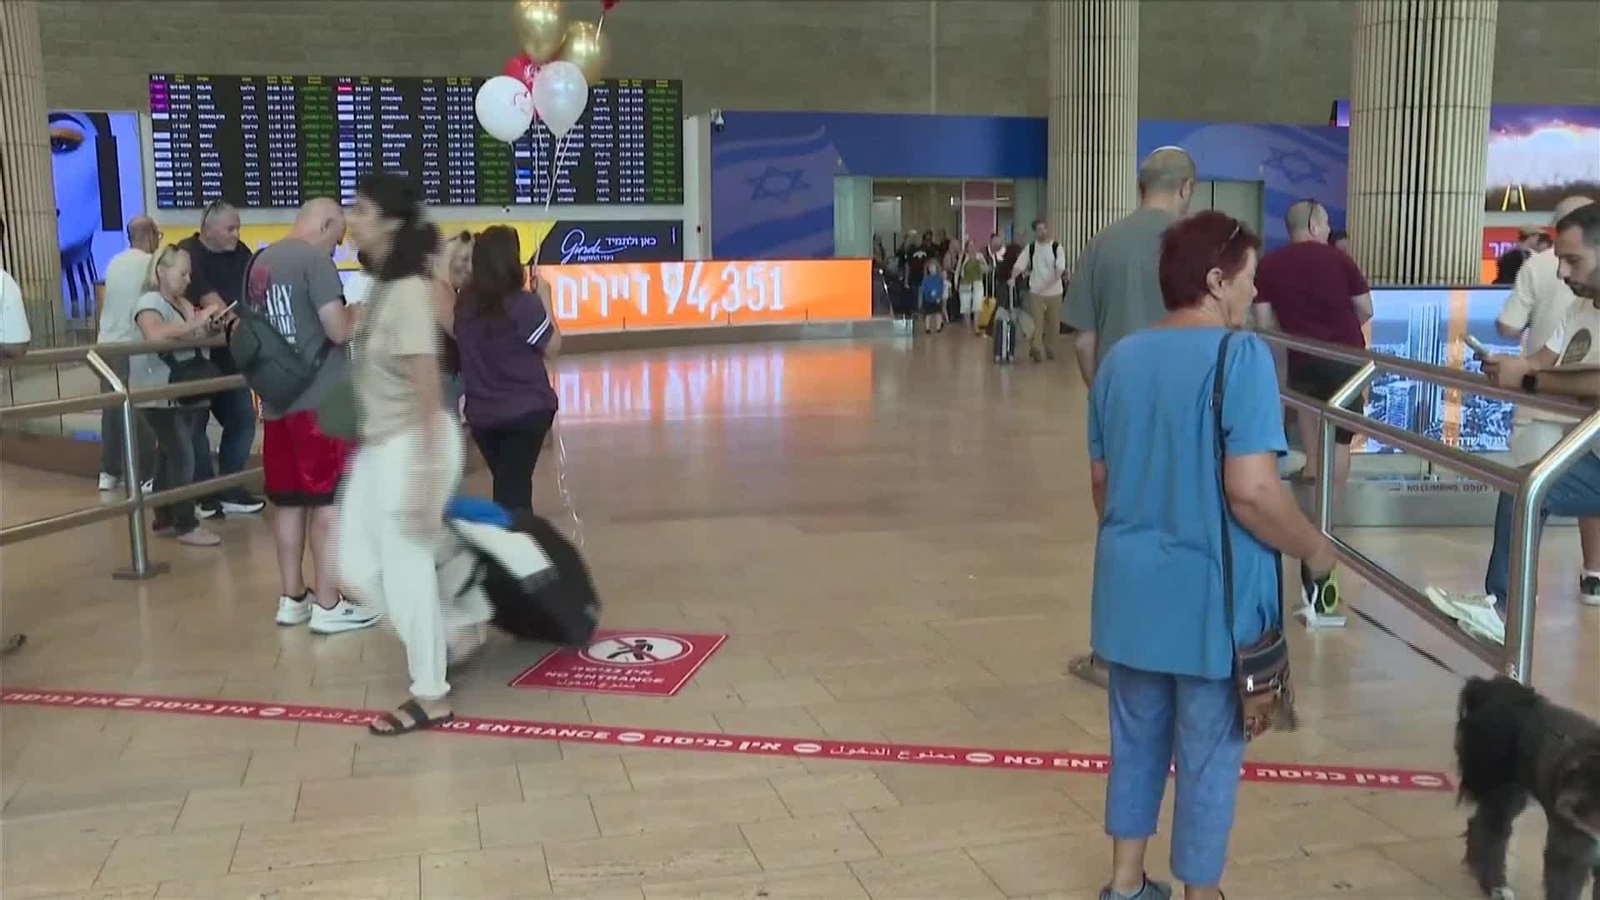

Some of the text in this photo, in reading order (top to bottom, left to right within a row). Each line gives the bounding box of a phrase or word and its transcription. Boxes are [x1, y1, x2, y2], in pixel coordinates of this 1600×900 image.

[605, 236, 657, 248] כאן ולתמיד
[557, 261, 786, 321] 94,351 דיירים
[545, 671, 666, 684] NO ENTRANCE
[73, 696, 115, 706] אין
[143, 699, 254, 716] אין כניסה
[475, 722, 611, 742] ENTRANCE
[652, 734, 783, 752] אין כניסה
[1003, 756, 1044, 767] NO
[1256, 767, 1401, 785] אין כניסה
